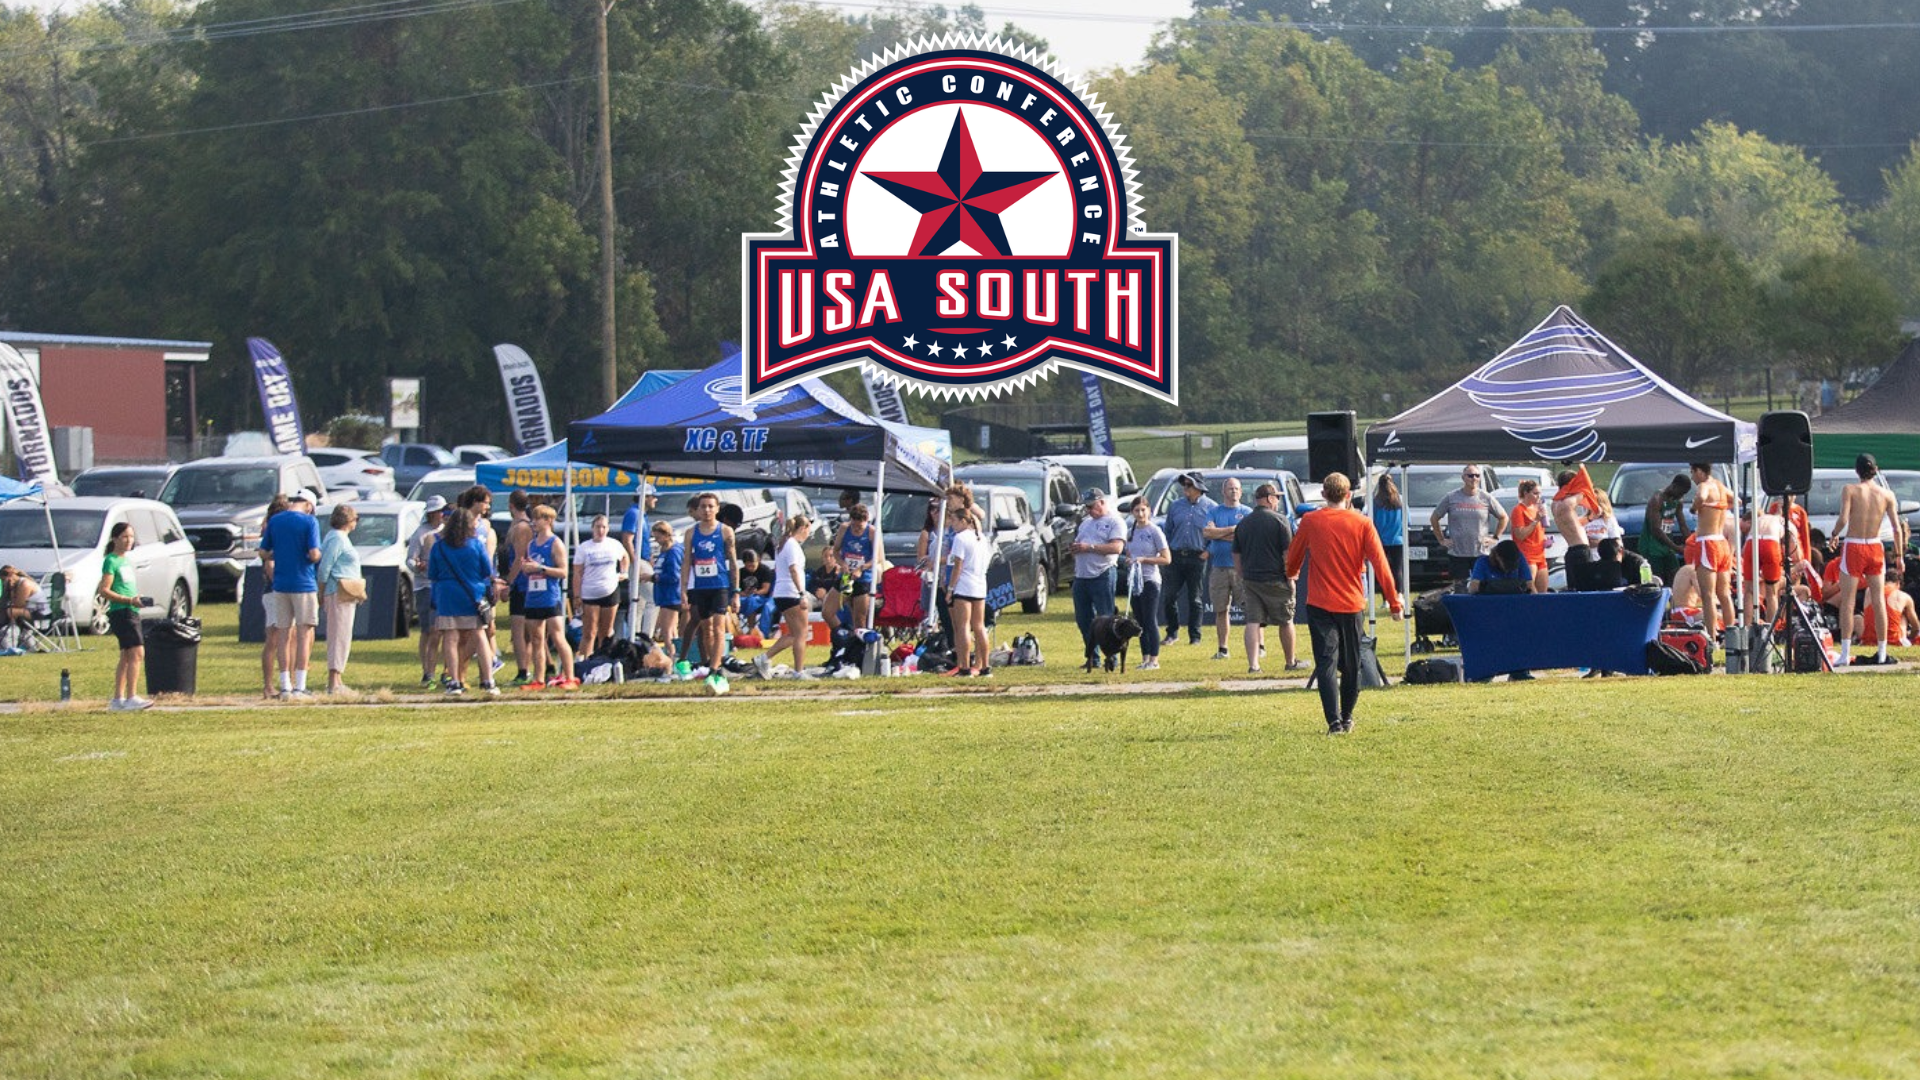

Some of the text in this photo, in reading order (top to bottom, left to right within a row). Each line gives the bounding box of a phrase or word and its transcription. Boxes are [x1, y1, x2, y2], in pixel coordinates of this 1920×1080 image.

[262, 374, 292, 409] DAY
[1086, 386, 1102, 408] DAY
[8, 377, 50, 477] TORNADOS
[271, 412, 303, 456] AME
[511, 375, 547, 454] ORNADOS
[684, 427, 769, 452] XC & TF
